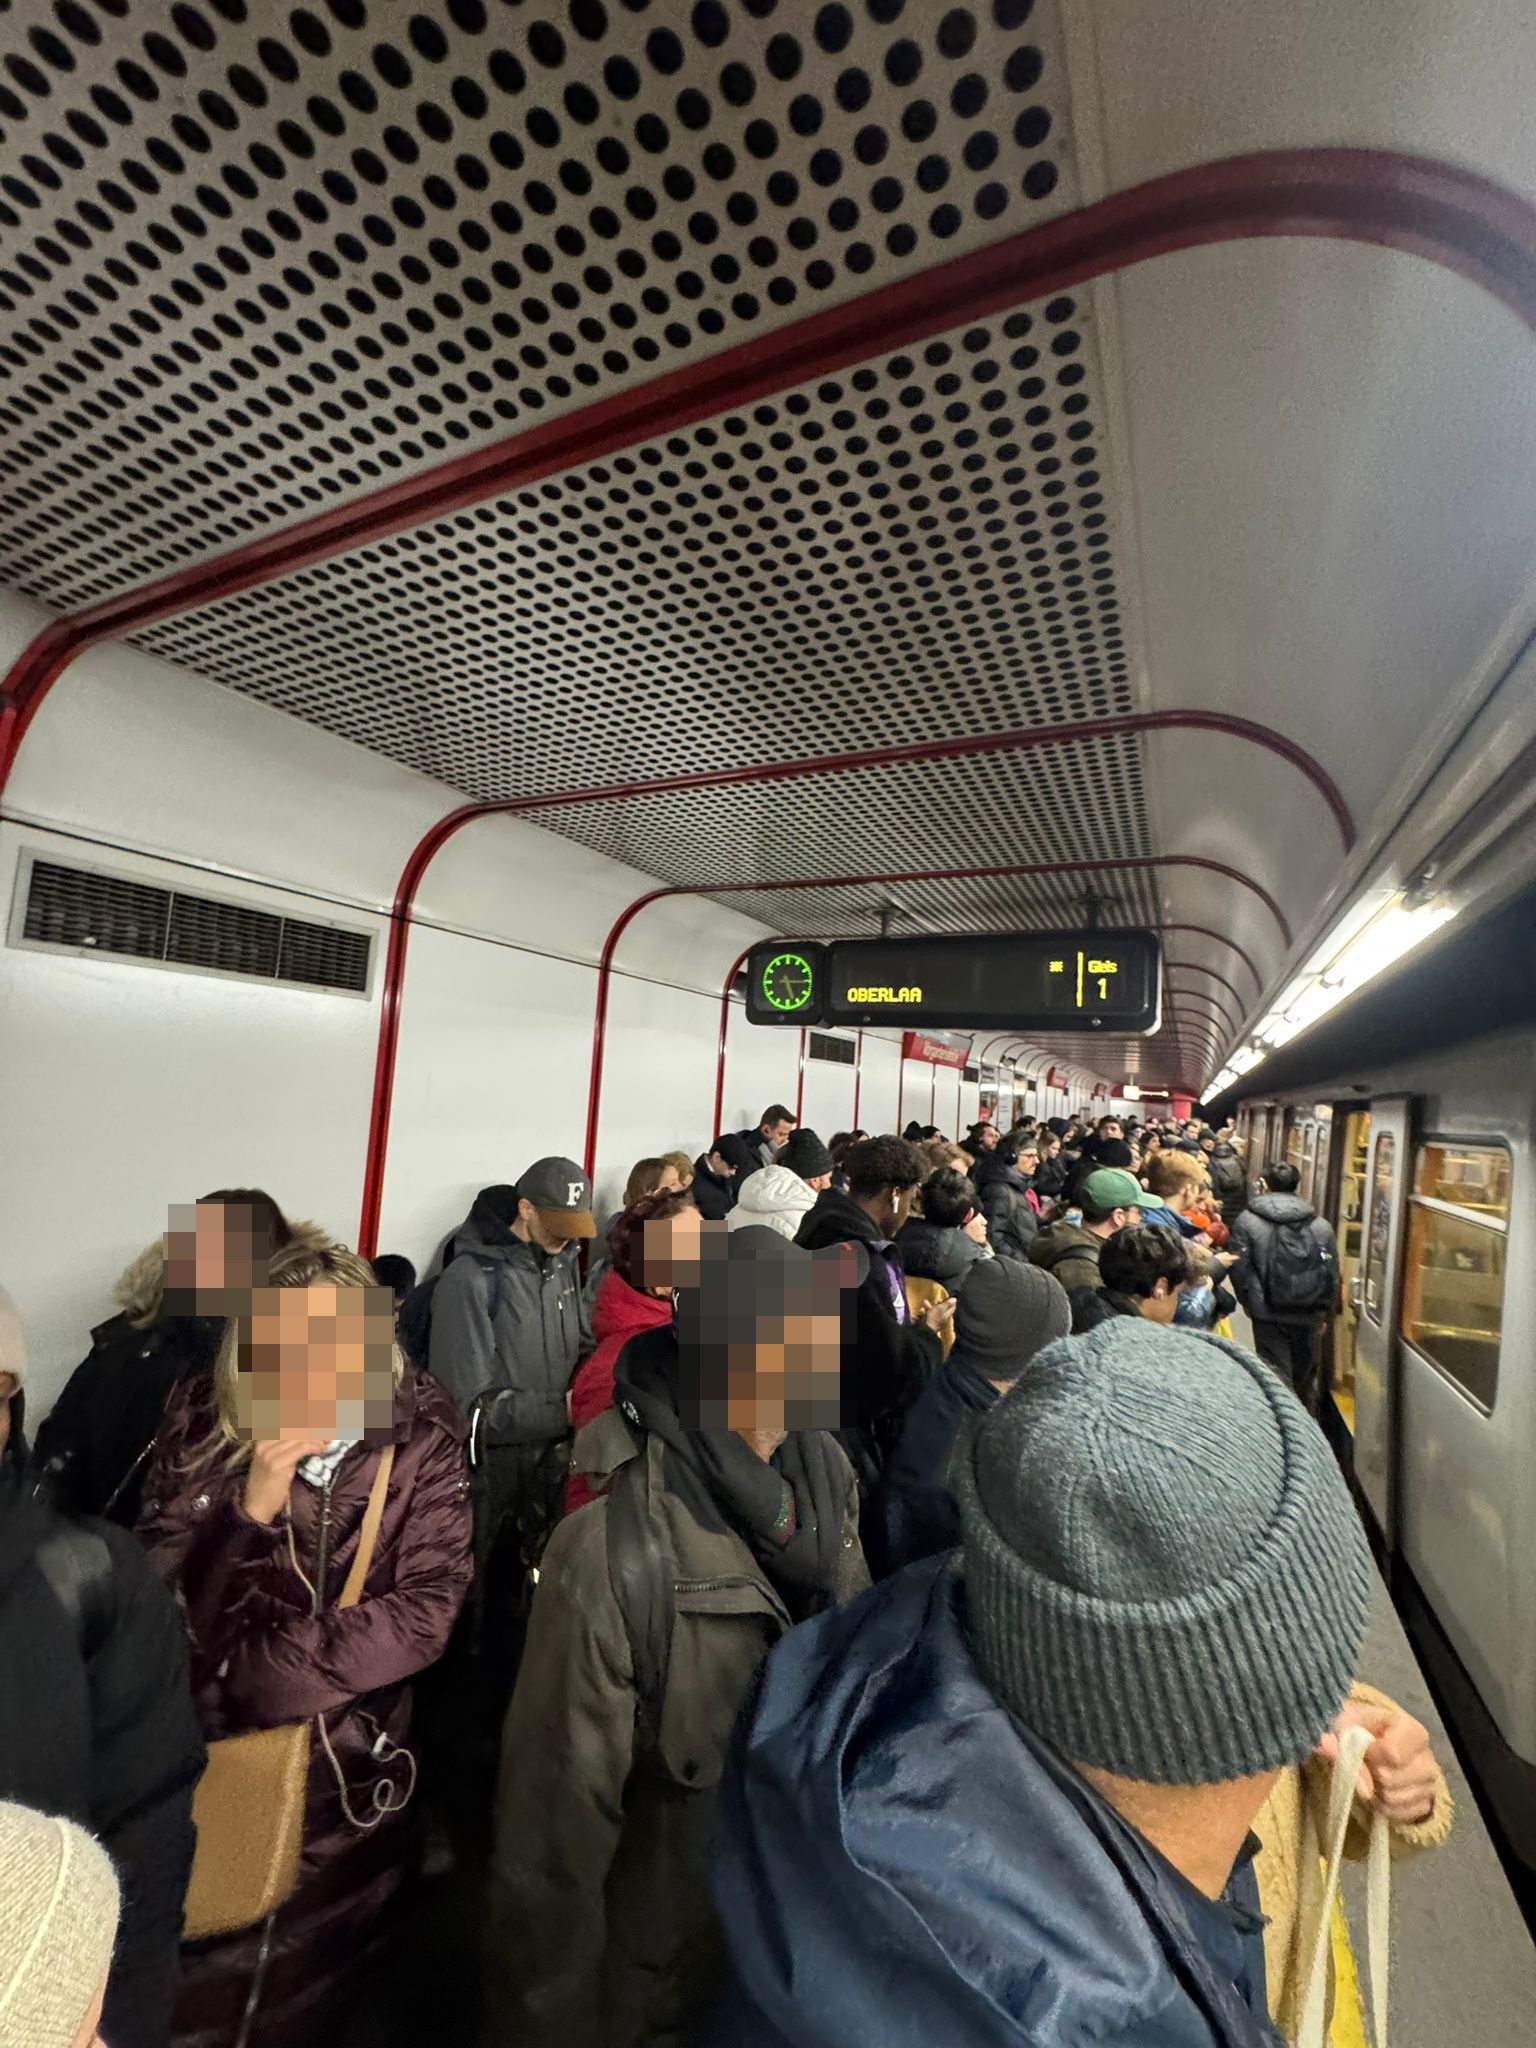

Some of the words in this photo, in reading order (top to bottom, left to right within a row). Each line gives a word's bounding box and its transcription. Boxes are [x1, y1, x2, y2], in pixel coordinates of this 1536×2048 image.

[847, 987, 922, 1003] OBERLAA
[1097, 978, 1106, 1000] 1
[566, 1182, 584, 1205] F
